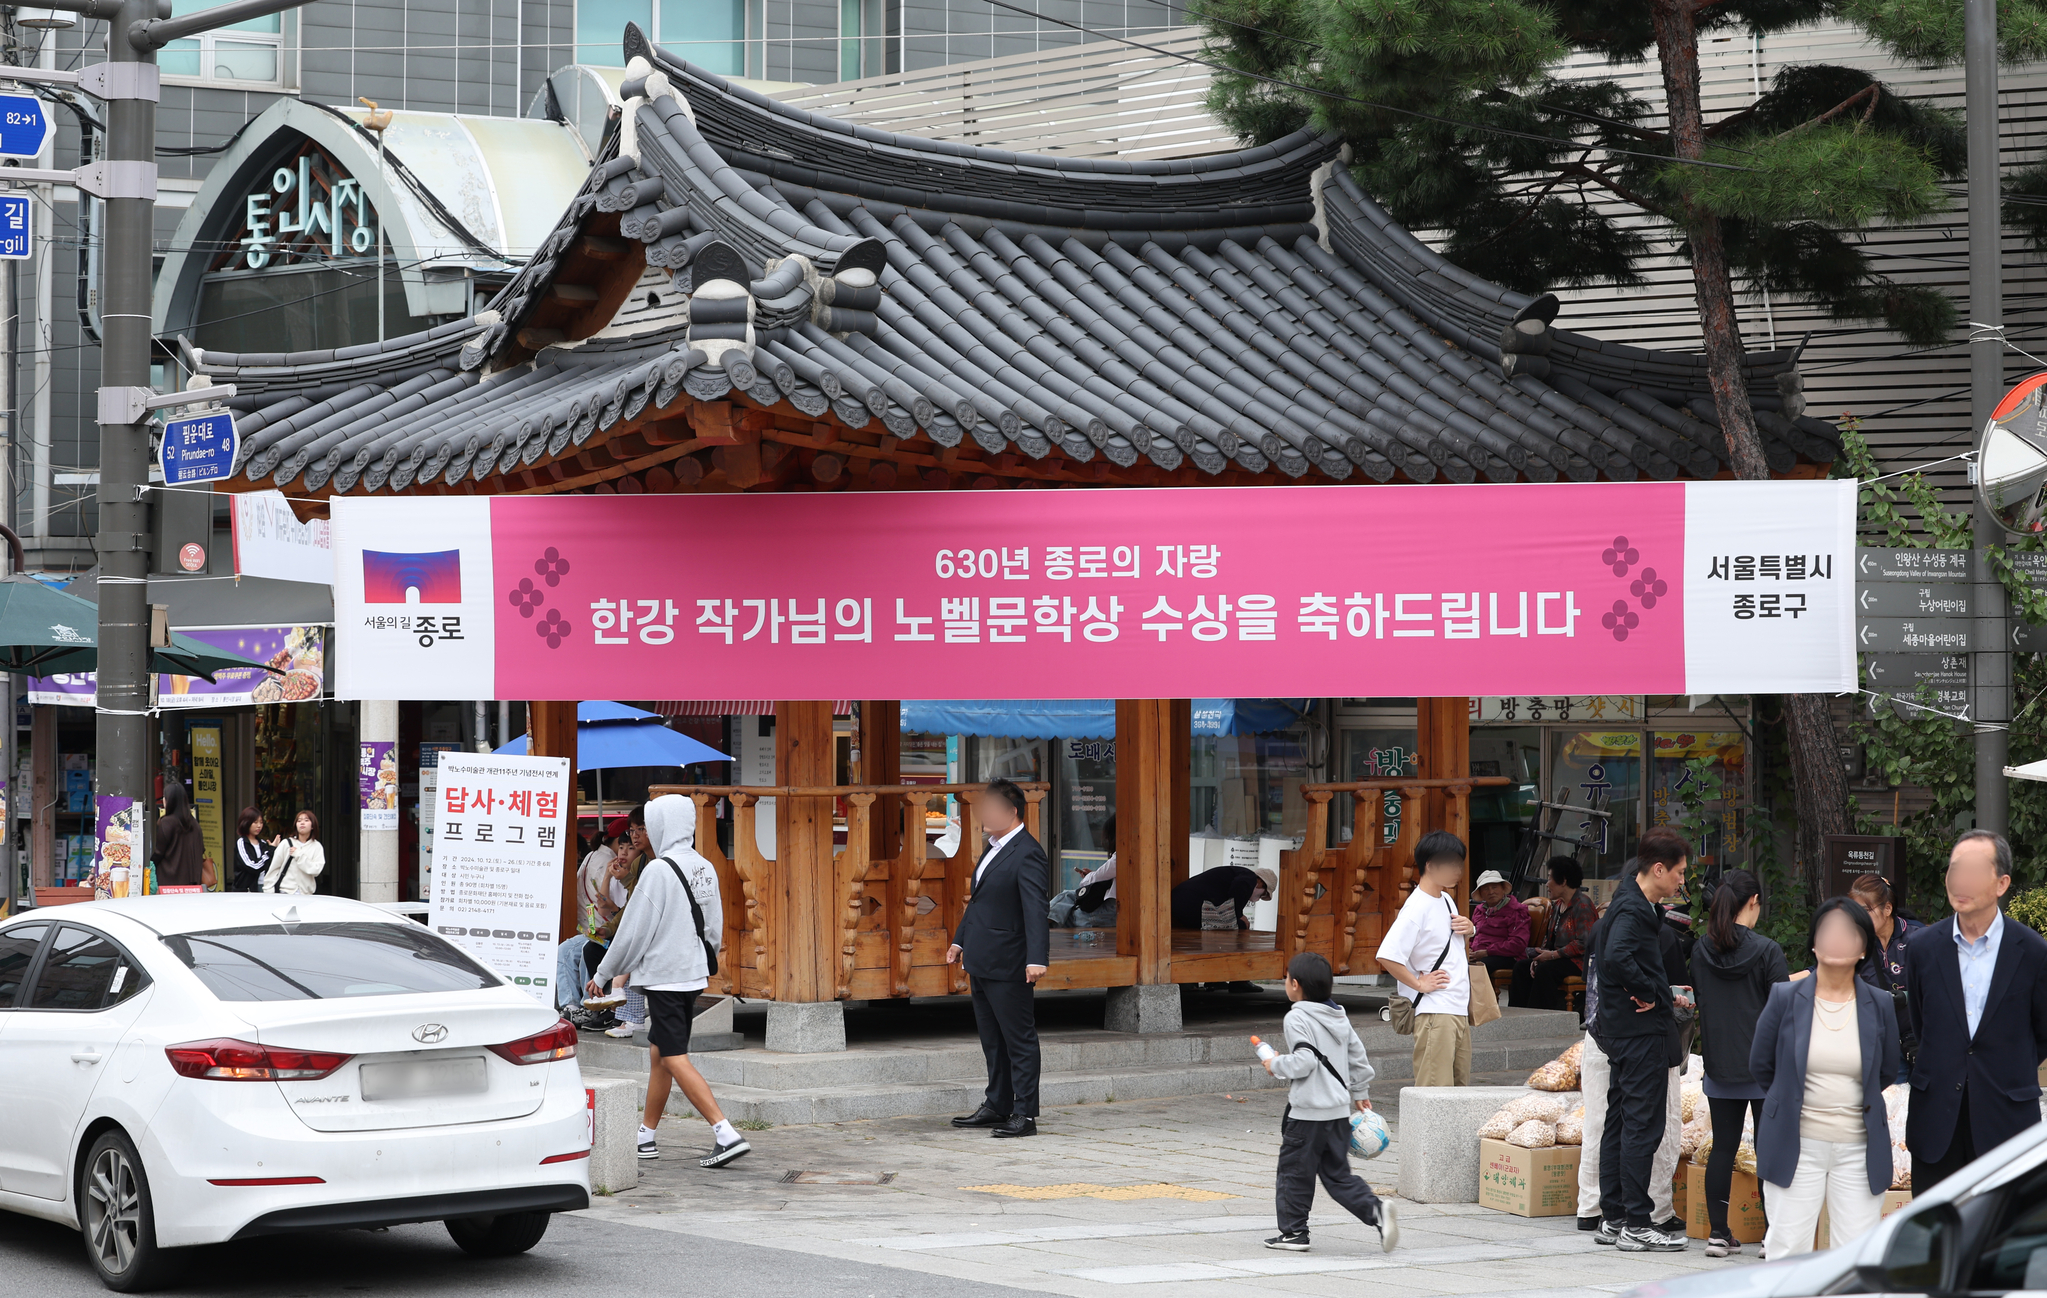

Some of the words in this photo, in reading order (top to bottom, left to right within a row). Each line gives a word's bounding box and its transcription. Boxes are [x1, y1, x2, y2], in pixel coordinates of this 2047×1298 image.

[240, 156, 375, 269] 통인시장
[182, 422, 215, 445] 필운대로
[221, 438, 231, 452] 48
[167, 446, 175, 460] 52
[181, 447, 215, 461] Pirundae-ro
[935, 546, 1030, 580] 630년
[1044, 545, 1141, 580] 종로의
[1155, 544, 1222, 579] 자랑
[1895, 552, 1920, 568] 인왕산
[1922, 553, 1947, 568] 수성동
[1949, 554, 1966, 568] 계곡
[1707, 554, 1833, 581] 서울특별시
[1882, 569, 1909, 578] Suseongdong
[1927, 570, 1947, 578] Inwangsan
[1919, 588, 1931, 598] 구립
[1733, 593, 1807, 620] 종로구
[1919, 600, 1966, 613] 누상어린이집
[590, 598, 679, 646] 한강
[696, 597, 873, 646] 작가님의
[894, 594, 1125, 643] 노벨문학상
[1141, 594, 1278, 643] 수상을
[1297, 590, 1581, 641] 축하드립니다
[364, 616, 397, 630] 서울의
[399, 616, 412, 630] 길
[413, 616, 465, 648] 종로
[1902, 623, 1914, 632] 구립
[1902, 634, 1967, 647] 세종마을어린이집
[1937, 690, 1966, 703] 경복교회
[1501, 697, 1573, 721] 방충망
[195, 733, 217, 747] Hello.
[194, 756, 205, 767] 함께
[205, 757, 219, 768] 웃어요
[447, 765, 485, 775] 박노수미술관
[486, 767, 518, 777] 개관11주년
[519, 769, 544, 778] 기념전시
[545, 770, 559, 779] 연계
[198, 780, 217, 792] 통인시장
[445, 786, 558, 819] 답사·체험
[1722, 787, 1740, 853] 방범창
[444, 822, 556, 848] 프로그램
[294, 1094, 350, 1104] AVANTE
